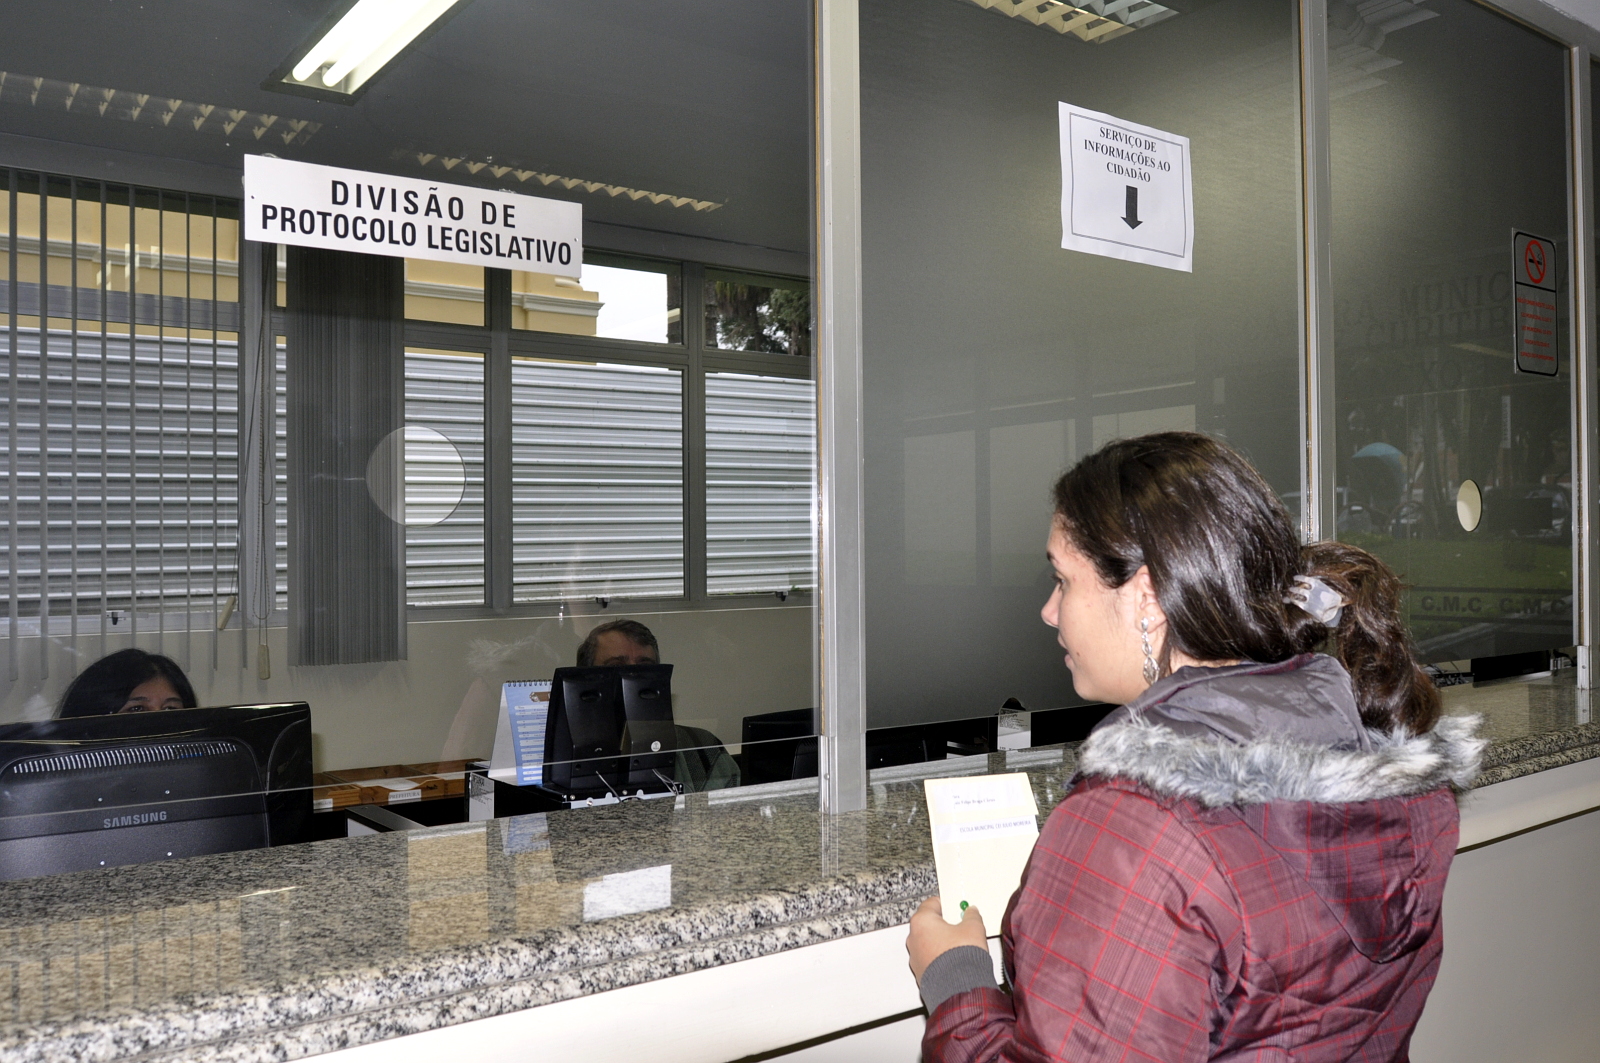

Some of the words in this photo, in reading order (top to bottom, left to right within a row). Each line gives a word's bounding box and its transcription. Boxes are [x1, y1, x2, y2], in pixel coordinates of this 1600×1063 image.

[1100, 127, 1142, 149] SERVIÇO
[1144, 139, 1157, 153] DE
[1084, 139, 1155, 168] INFORMAÇÕES
[1157, 160, 1171, 172] AO
[1106, 161, 1151, 183] CIDADÃO
[331, 180, 464, 222] DIVISÃO
[481, 200, 516, 229] DE
[261, 204, 417, 247] PROTOCOLO
[427, 224, 571, 266] LEGISLATIVO
[389, 791, 420, 800] PREFEITURA
[103, 811, 167, 829] SAMSUNG
